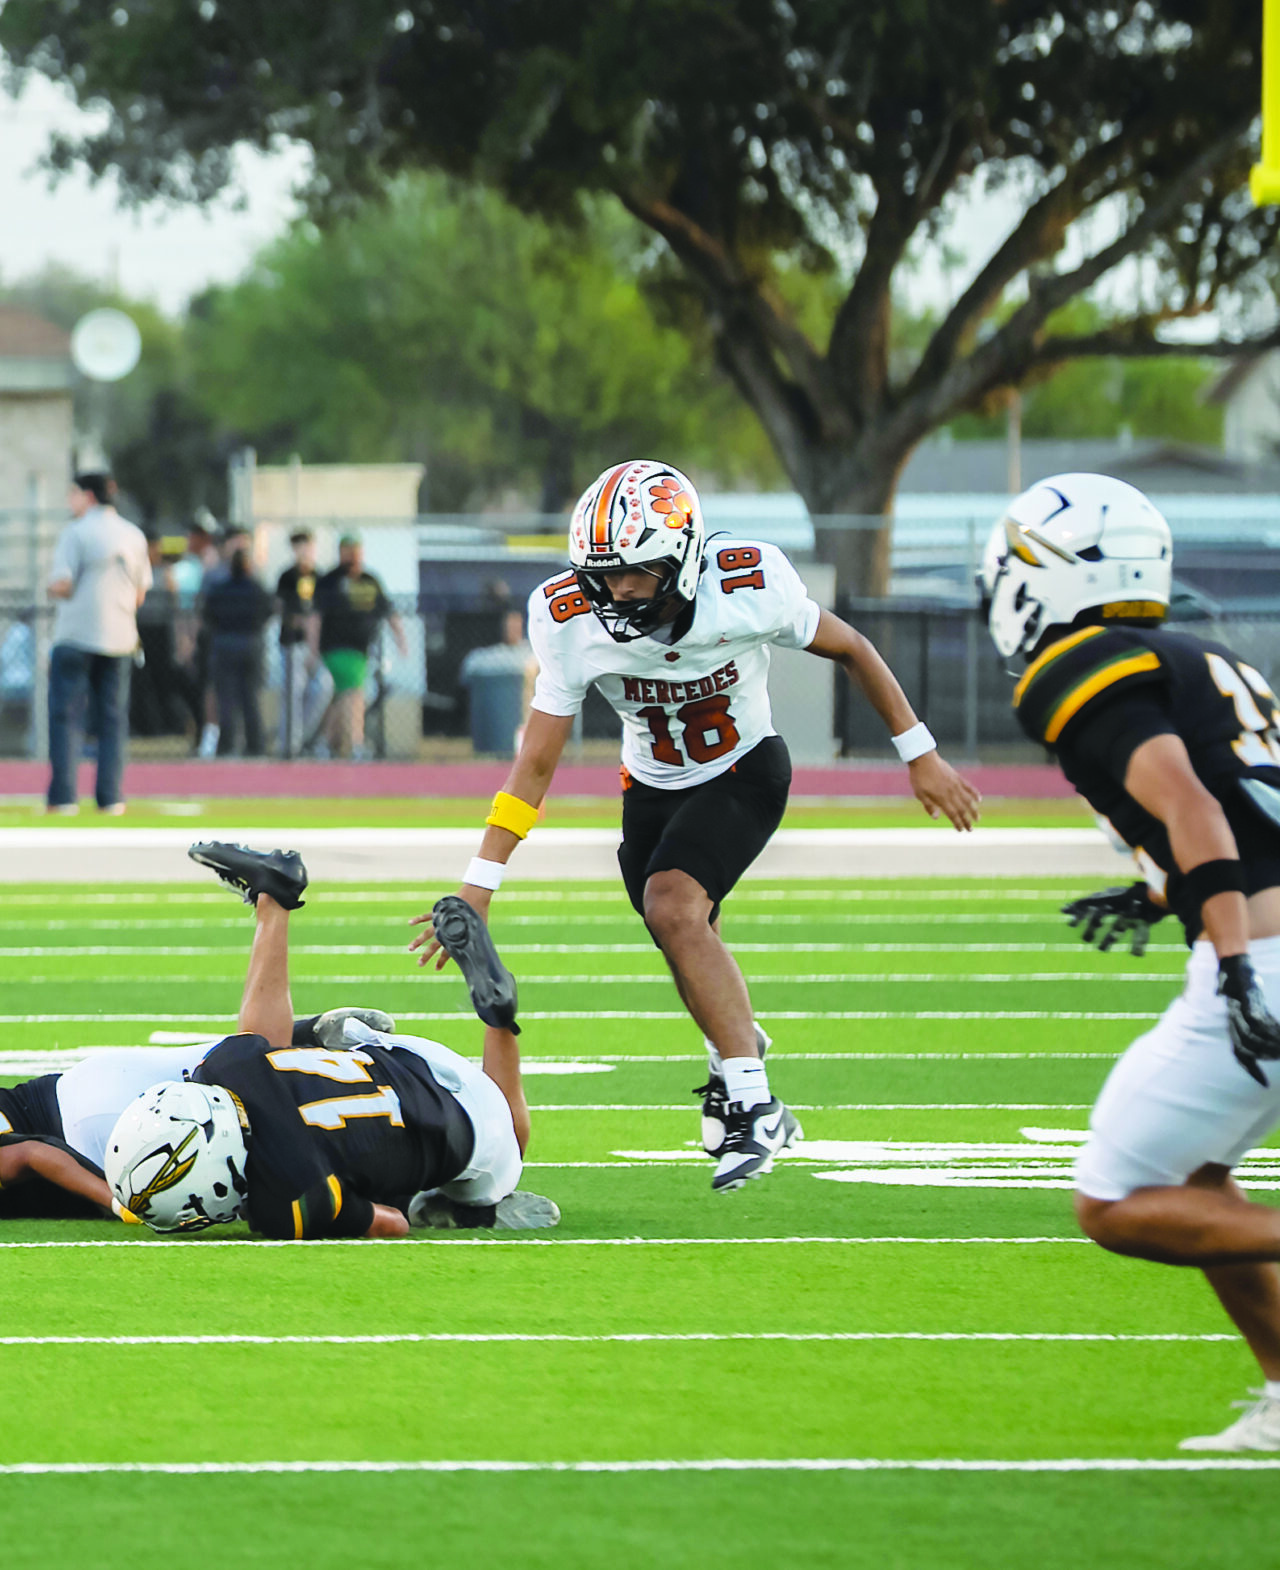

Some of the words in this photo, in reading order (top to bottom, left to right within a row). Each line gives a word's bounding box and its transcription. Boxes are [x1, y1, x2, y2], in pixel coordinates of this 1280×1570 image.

[586, 557, 621, 568] Riddell
[717, 547, 766, 594] 18
[543, 573, 592, 624] 18
[622, 659, 740, 704] MERCEDES
[636, 693, 741, 768] 18
[264, 1046, 406, 1131] 14
